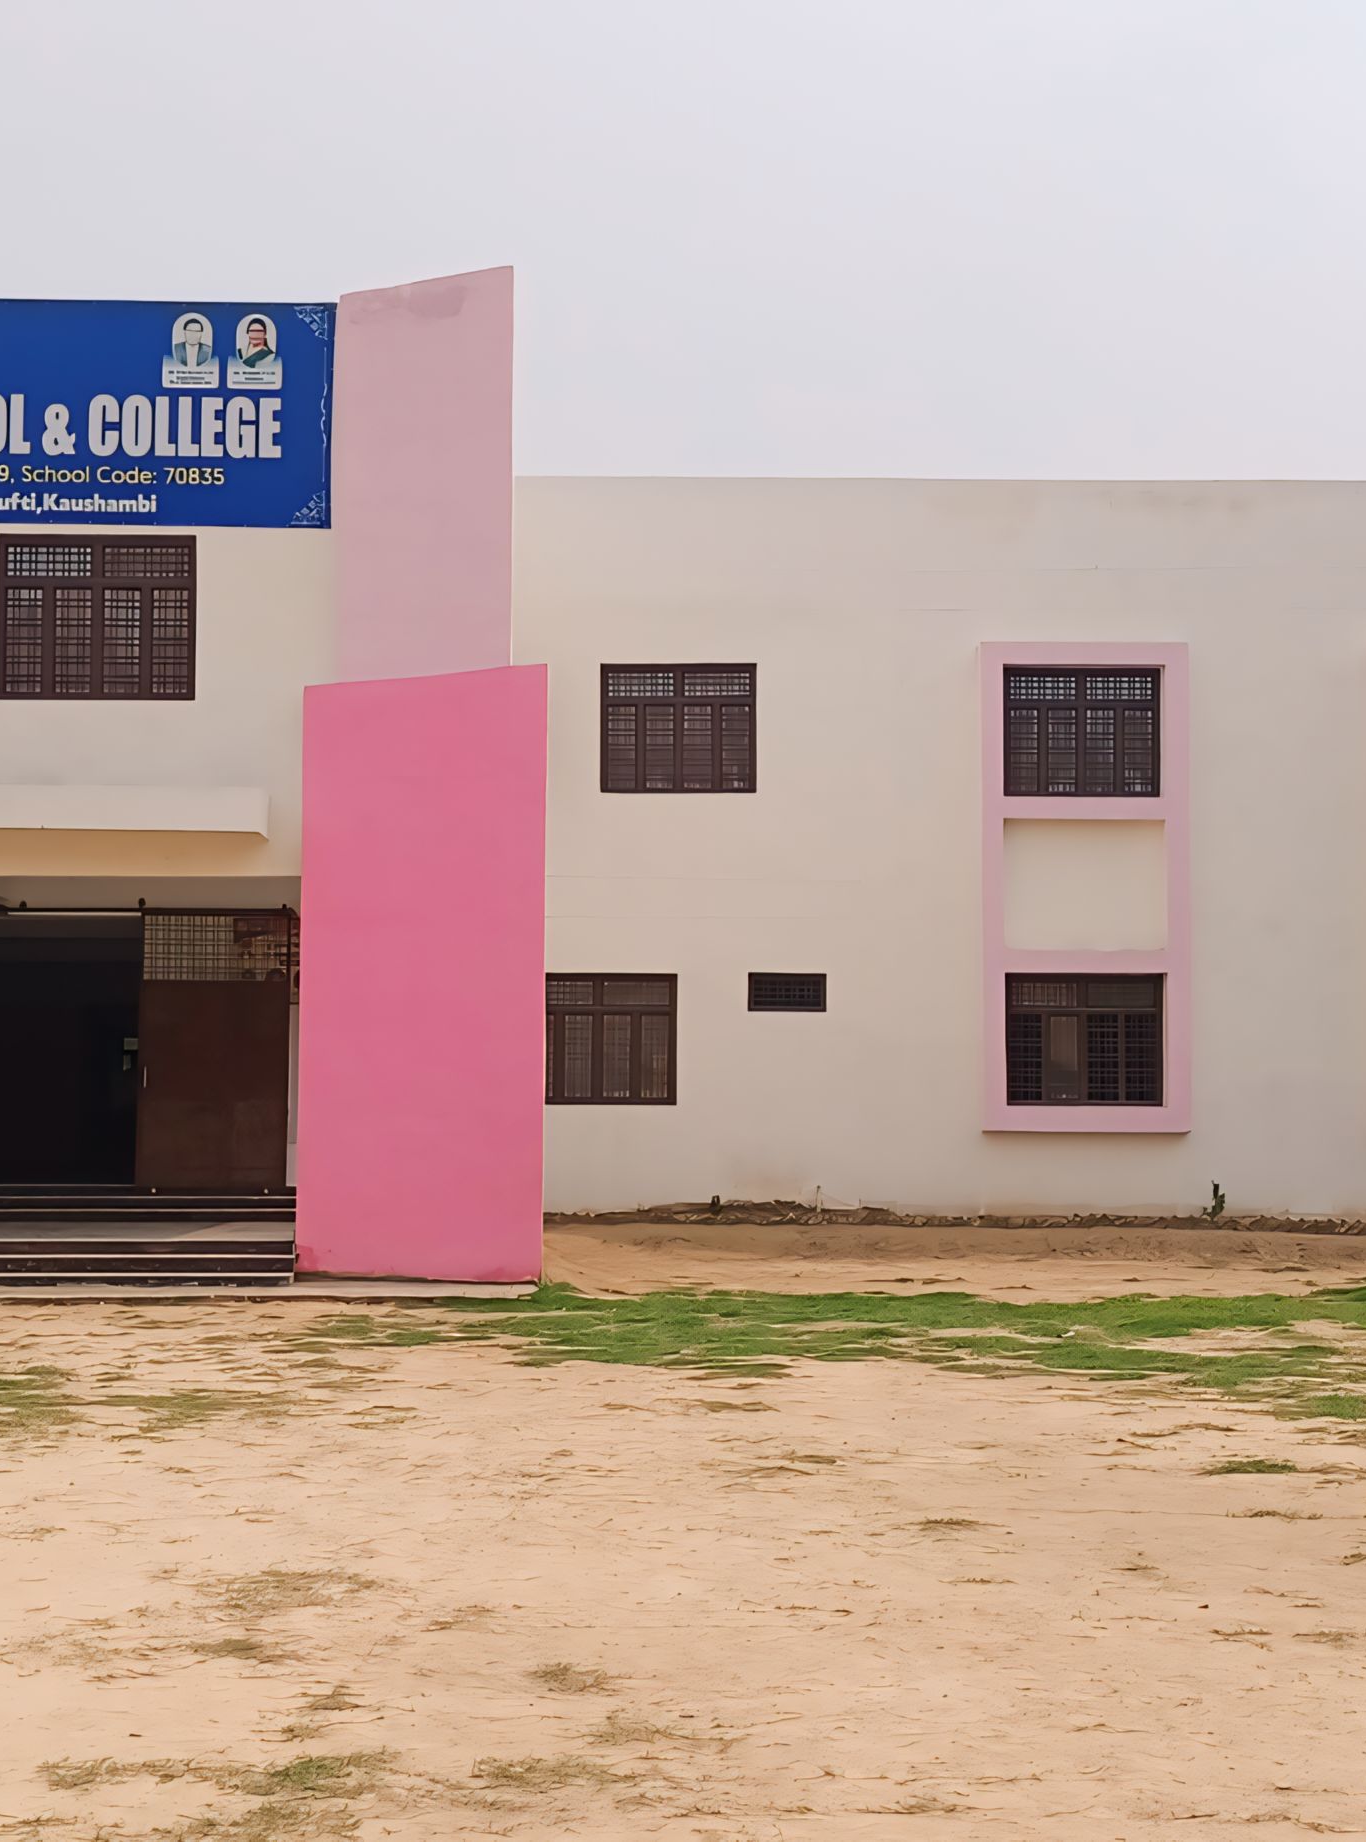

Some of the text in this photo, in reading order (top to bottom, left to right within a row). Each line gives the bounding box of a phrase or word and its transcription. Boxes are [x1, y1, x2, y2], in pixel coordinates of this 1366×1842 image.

[41, 403, 76, 456] &
[88, 393, 282, 459] COLLEGE
[21, 465, 90, 483] School
[96, 466, 157, 485] Code:
[163, 467, 225, 485] 70835
